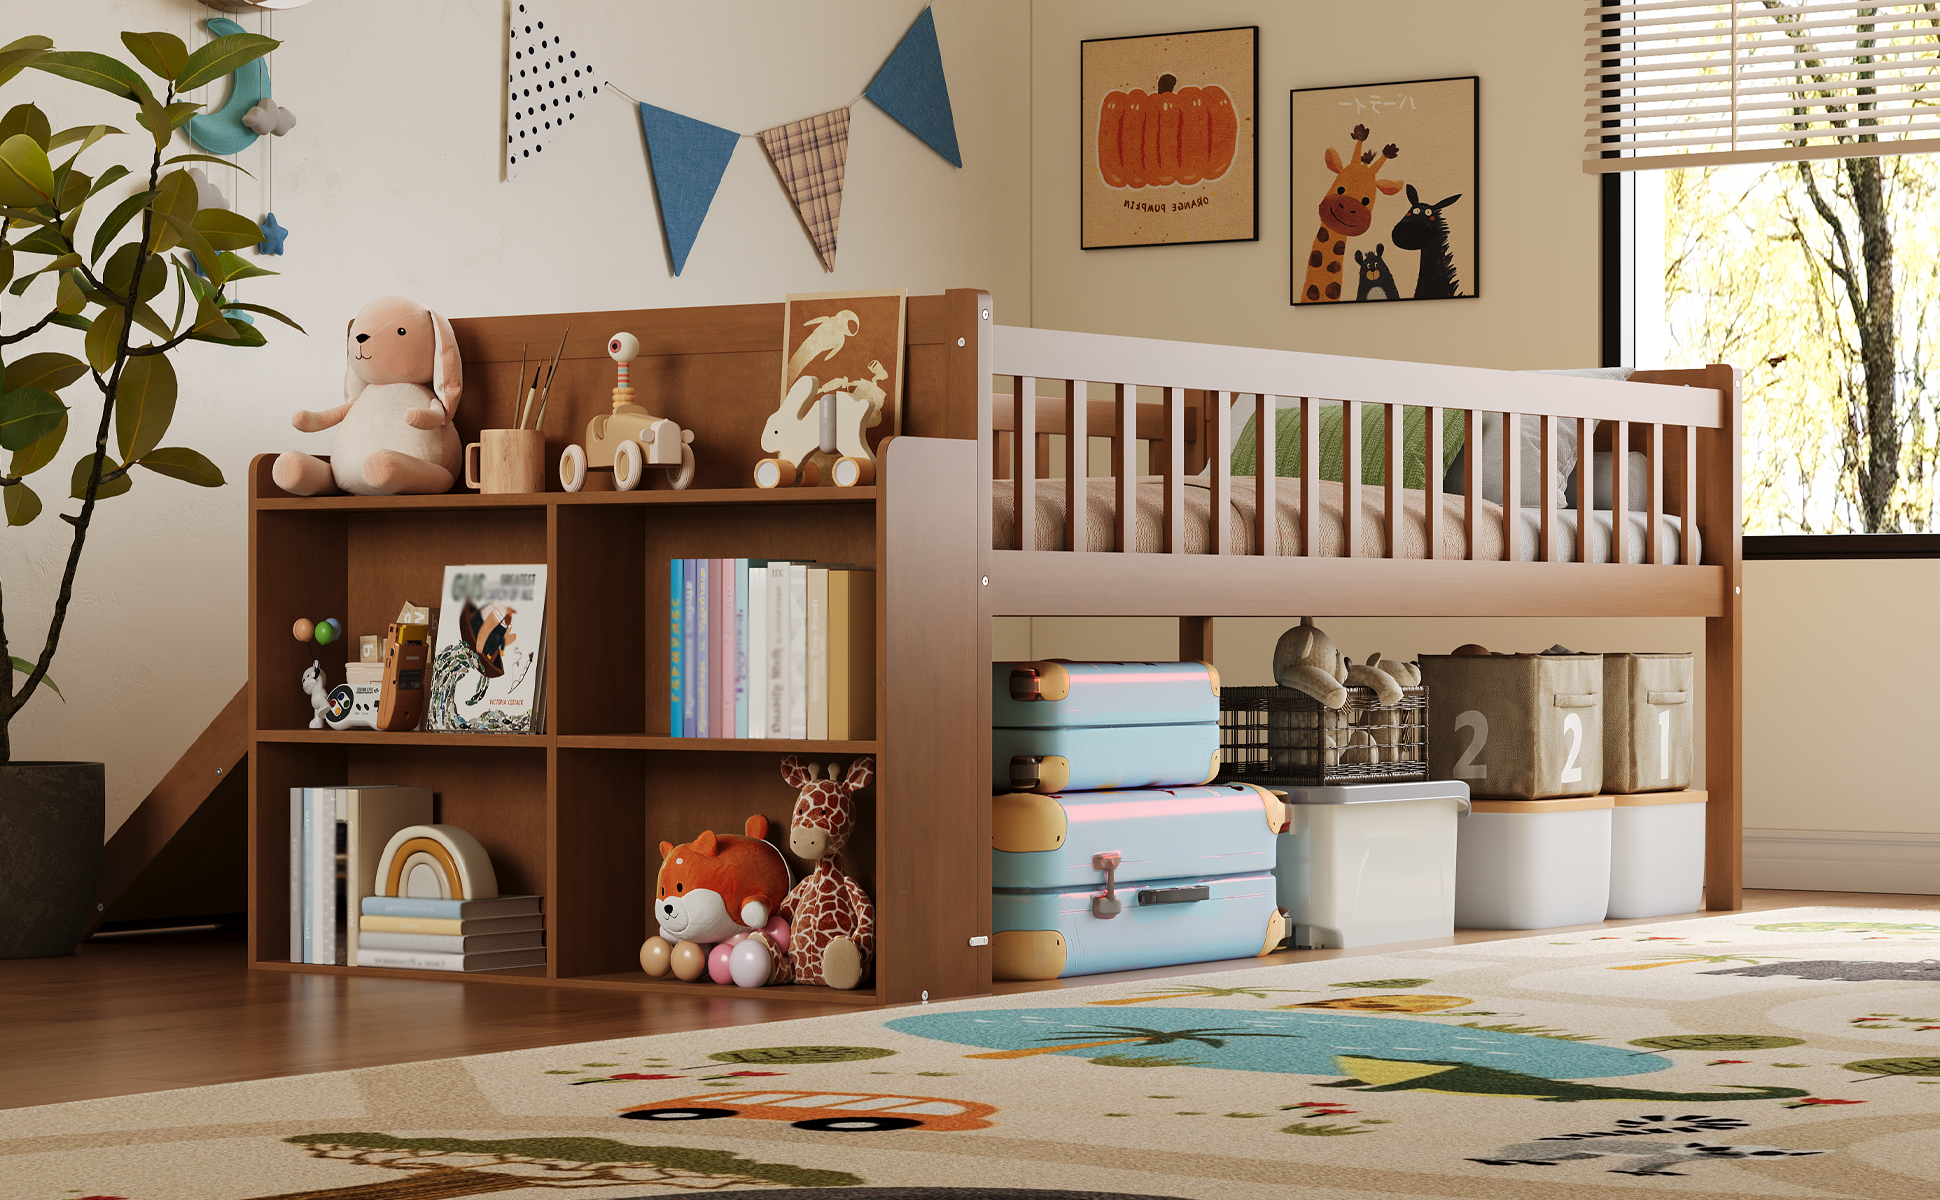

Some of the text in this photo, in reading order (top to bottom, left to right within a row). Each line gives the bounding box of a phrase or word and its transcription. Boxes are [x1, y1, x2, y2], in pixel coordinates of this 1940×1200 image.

[1452, 709, 1489, 780] 2
[1561, 712, 1583, 784] 2
[1658, 709, 1670, 780] 1
